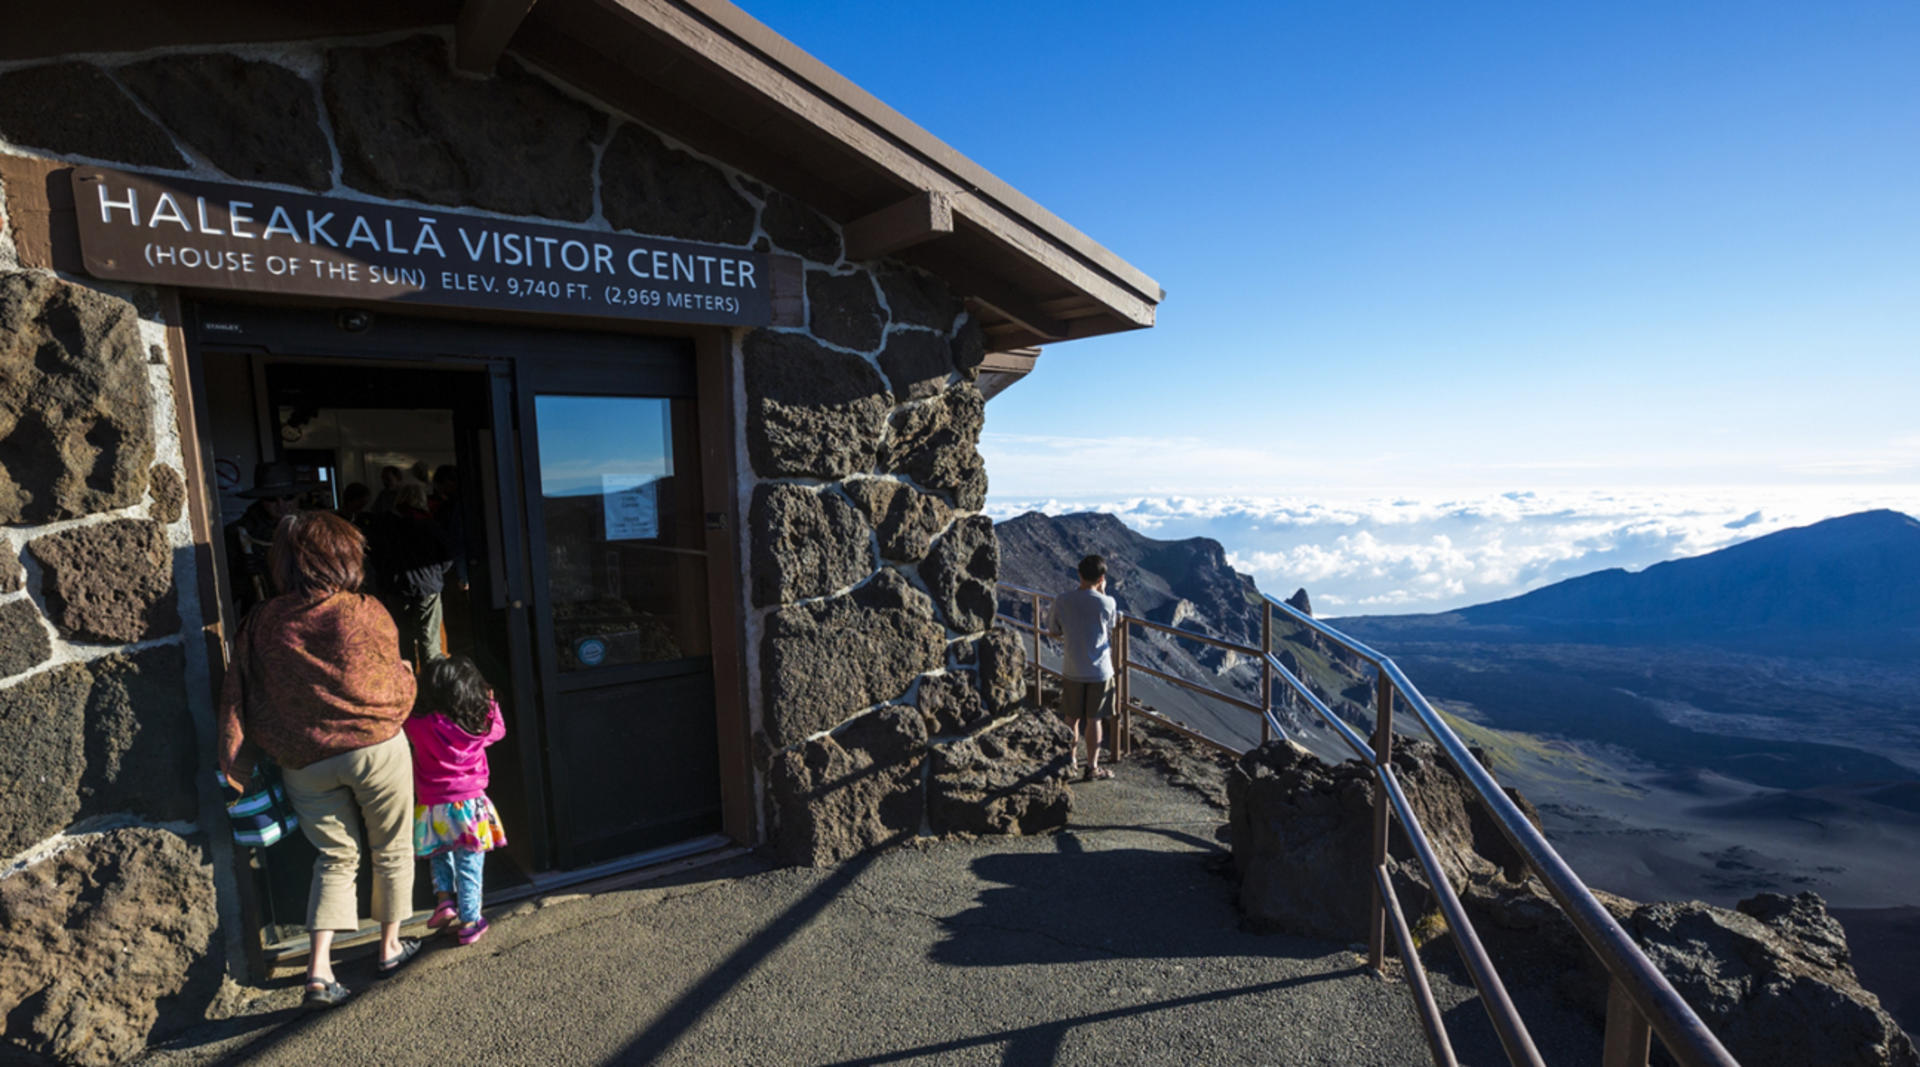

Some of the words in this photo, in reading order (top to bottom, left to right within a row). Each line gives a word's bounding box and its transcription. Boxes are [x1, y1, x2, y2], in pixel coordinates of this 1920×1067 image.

[97, 184, 447, 258] HALEAKALĀ
[458, 227, 616, 275] VISITOR
[627, 248, 757, 289] CENTER
[144, 243, 256, 273] (HOUSE
[266, 255, 302, 276] OF
[310, 259, 360, 281] THE
[369, 265, 426, 290] SUN)
[441, 272, 499, 293] ELEV.
[507, 278, 560, 299] 9,740
[567, 283, 592, 300] FT.
[604, 285, 661, 307] (2,969
[667, 292, 740, 315] METERS)
